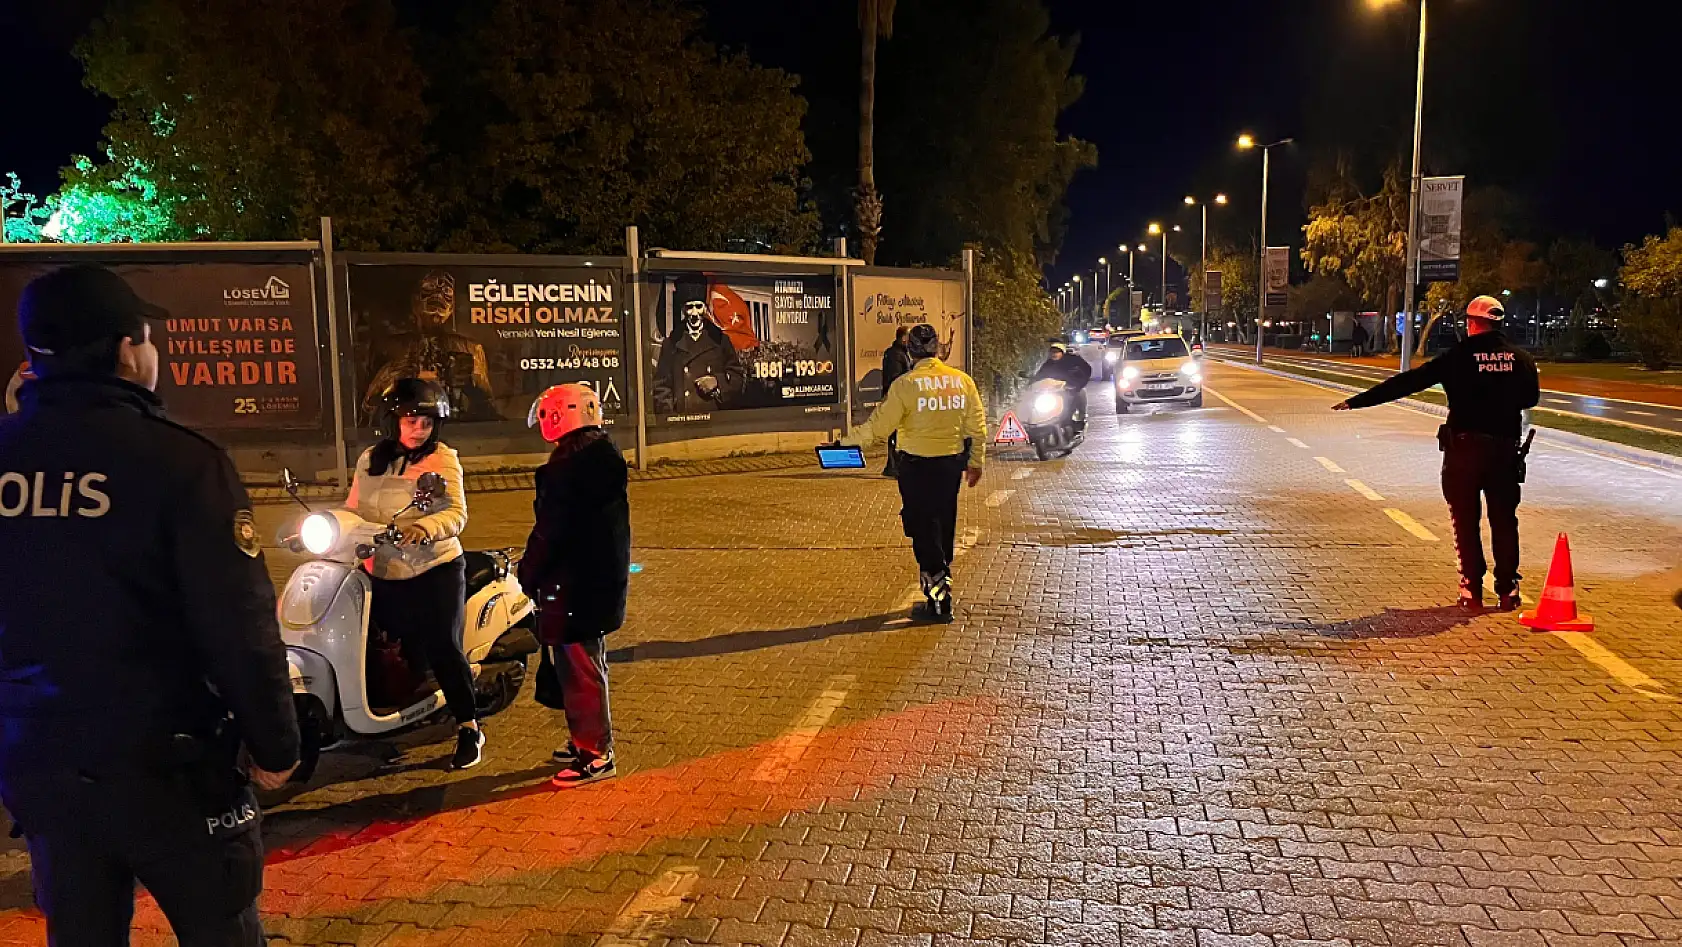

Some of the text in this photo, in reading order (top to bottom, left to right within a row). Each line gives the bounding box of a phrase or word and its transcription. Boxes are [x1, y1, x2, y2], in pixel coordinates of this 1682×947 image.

[1425, 181, 1459, 192] SERVET
[469, 279, 613, 302] EĞLENCENİN
[774, 295, 795, 309] SAYGI
[803, 293, 831, 309] ÖZLEMLE
[470, 302, 619, 324] RİSKİ OLMAZ.
[166, 318, 293, 333] UMUT VARSA
[535, 329, 556, 338] Yeni
[557, 328, 580, 338] Nesil
[168, 336, 295, 358] İYİLEŞME DE
[520, 357, 620, 370] 0532 449 48 08
[754, 360, 783, 380] 1881
[170, 361, 298, 386] VARDIR
[234, 398, 260, 414] 25.
